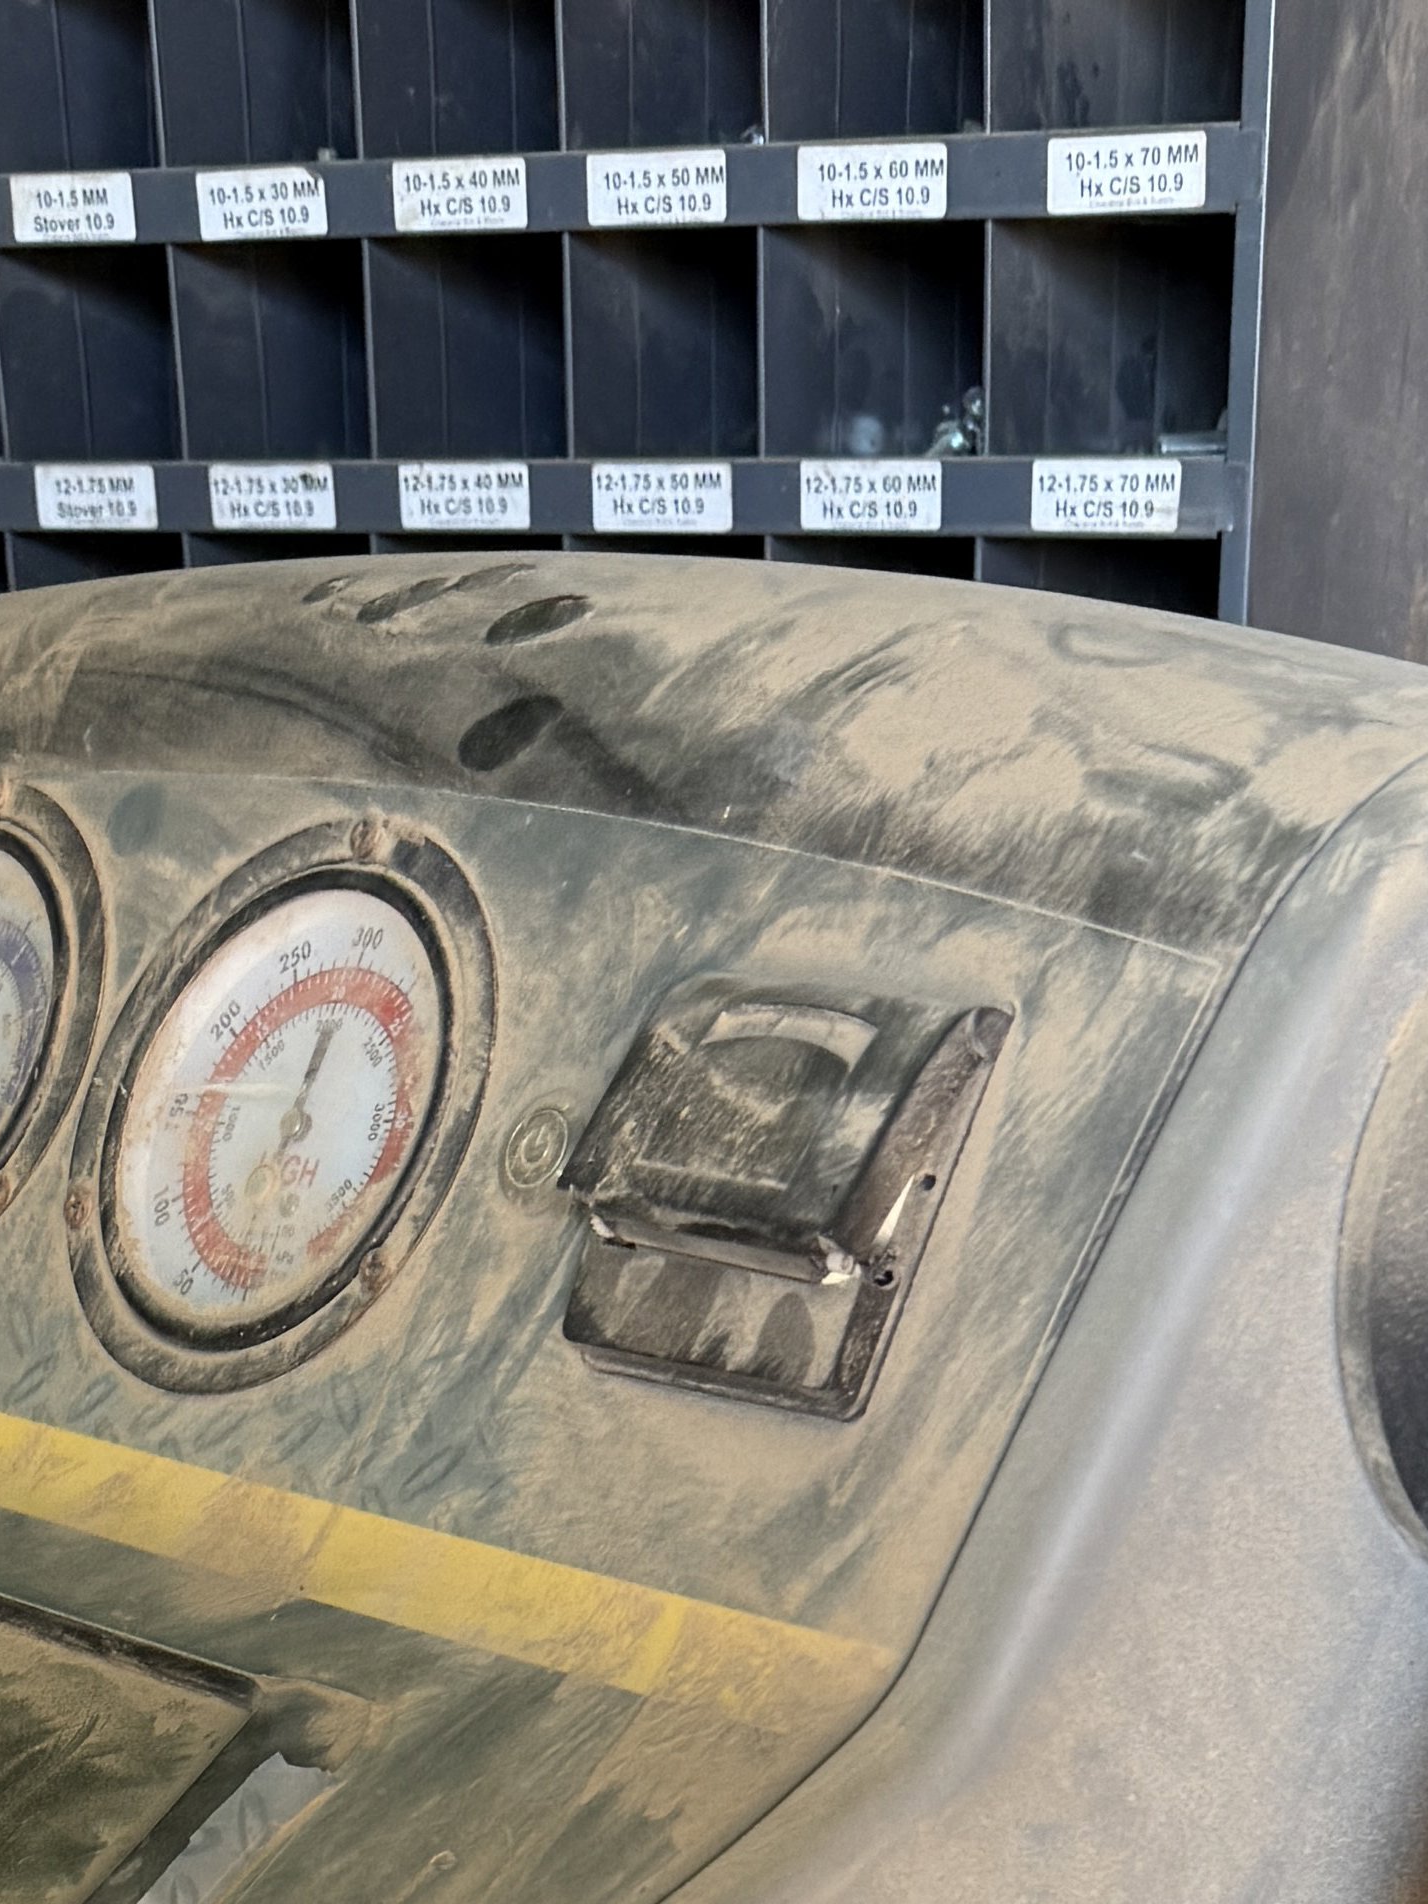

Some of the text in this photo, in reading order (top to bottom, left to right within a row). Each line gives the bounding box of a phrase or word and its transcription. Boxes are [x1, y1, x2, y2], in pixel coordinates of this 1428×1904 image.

[1066, 143, 1199, 172] 10-1.5 x 70 MM
[404, 168, 520, 193] 10-1.5 x 40 MM
[604, 165, 723, 191] 10-1.5 x 50 MM
[819, 158, 945, 182] 10-1.5 x 60 MM
[209, 179, 321, 206] 10-1.5 x 30 MM
[1080, 172, 1184, 198] Hx C/S 10.9
[36, 188, 108, 209] 10-1.5 MM
[420, 195, 511, 217] Hx C/S 10.9
[617, 193, 712, 216] Hx C/S 10.9
[831, 186, 930, 208] Hx C/S 10.9
[34, 212, 115, 233] Stover 10.9
[223, 205, 310, 229] Hx C/S 10.9
[55, 477, 134, 495] 12-1.75 MM
[213, 477, 265, 496] 12-1.75
[270, 481, 277, 494] x
[403, 473, 523, 492] 12-1.75 x 40 MM
[596, 473, 722, 491] 12-1.75 x 50 MM
[806, 474, 937, 494] 12-1.75 x 60 MM
[1038, 473, 1176, 492] 12-1.75 x 70 MM
[57, 500, 137, 519] Stover 10.9
[230, 500, 314, 518] Hx C/S 10.9
[421, 496, 508, 515] Hx C/S 10.9
[613, 497, 705, 515] Hx C/S 10.9
[822, 500, 917, 518] Hx C/S 10.9
[1055, 499, 1154, 518] Hx C/S 10.9
[351, 926, 384, 951] 300
[278, 940, 313, 975] 250
[210, 999, 241, 1041] 200
[258, 1037, 286, 1073] 1500
[152, 1185, 171, 1228] 100
[173, 1274, 194, 1296] 50
